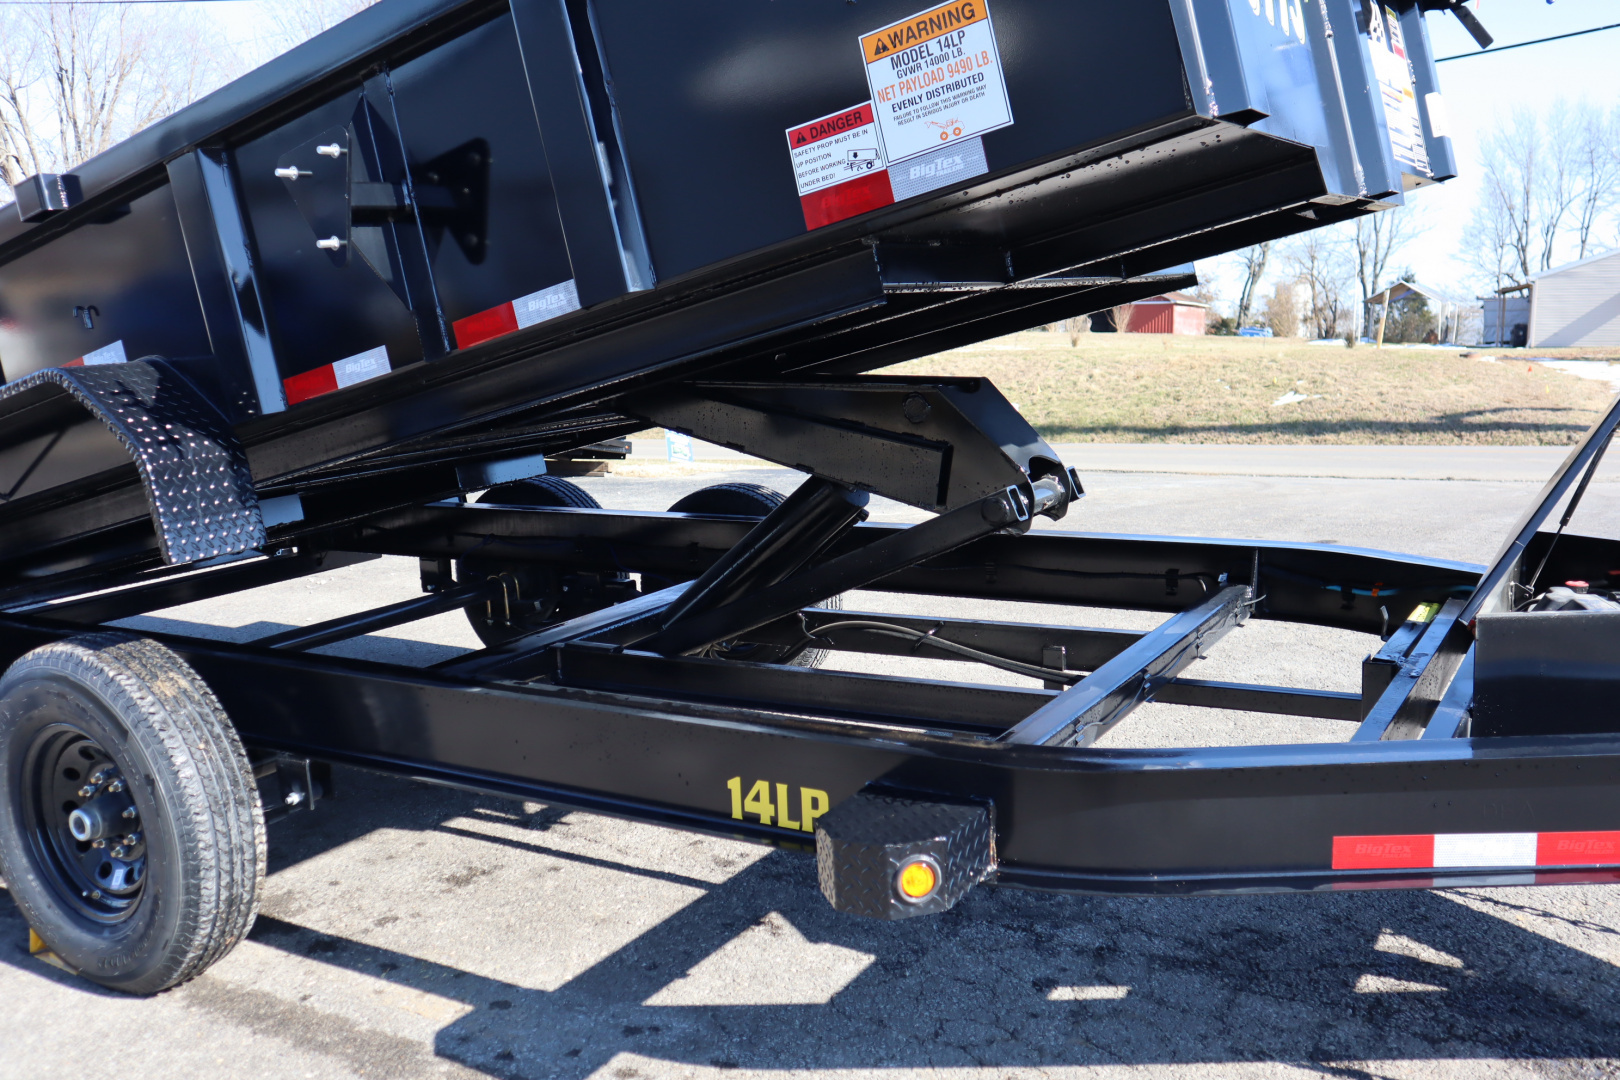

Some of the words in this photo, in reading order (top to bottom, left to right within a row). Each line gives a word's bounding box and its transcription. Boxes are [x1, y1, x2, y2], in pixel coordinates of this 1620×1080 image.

[888, 2, 976, 49] WARNING
[890, 43, 934, 70] MODEL
[936, 29, 966, 52] 14LP
[896, 62, 923, 79] GVWR
[925, 52, 950, 69] 14000
[952, 47, 966, 59] LB.
[877, 84, 896, 104] NET
[899, 67, 945, 96] PAYLOAD
[947, 56, 973, 78] 9490
[975, 50, 993, 69] LB.
[891, 94, 923, 113] EVENLY
[926, 72, 985, 101] DISTRIBUTED
[809, 111, 863, 139] DANGER
[793, 146, 816, 158] SAFETY
[816, 140, 833, 151] PROP
[834, 135, 851, 144] MUST
[852, 131, 861, 139] BE
[861, 128, 868, 136] IN
[796, 161, 804, 169] UP
[804, 152, 832, 166] POSITION
[797, 167, 819, 179] BEFORE
[820, 159, 846, 171] WORKING
[909, 154, 963, 180] BigTex
[800, 177, 821, 189] UNDER
[528, 292, 565, 312] BigTex
[345, 358, 376, 374] BigTex
[727, 776, 829, 832] 14LP
[1354, 843, 1412, 857] BigTex
[1556, 839, 1616, 853] BigTex
